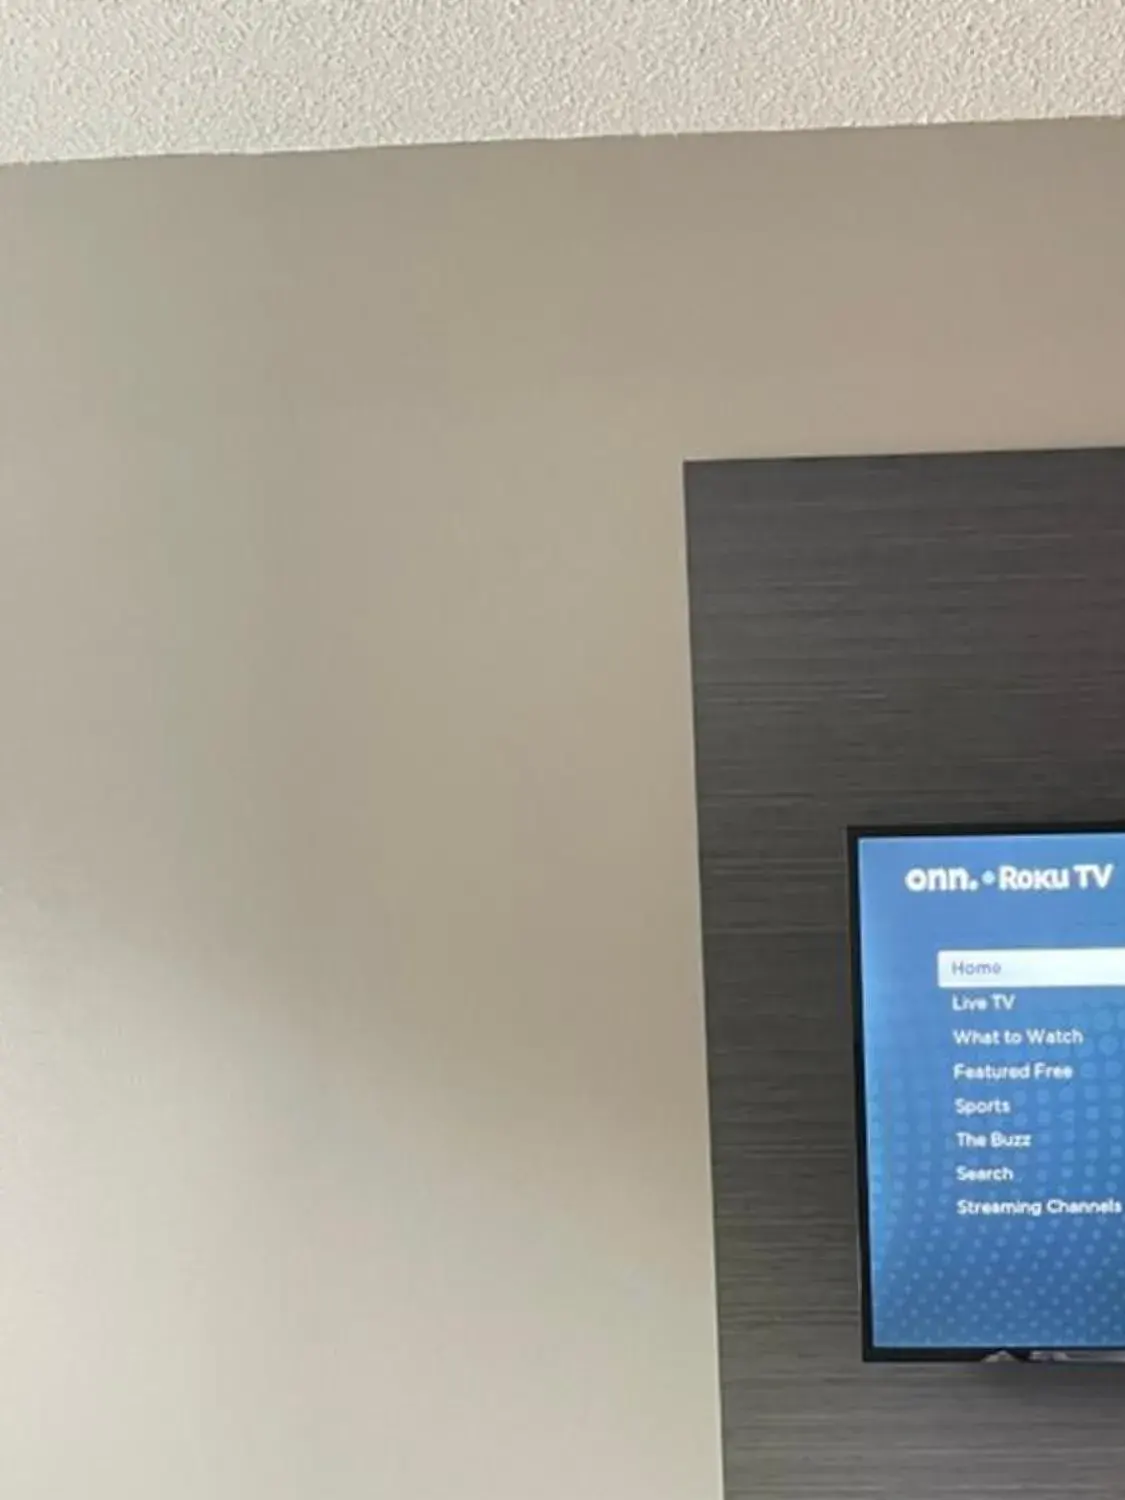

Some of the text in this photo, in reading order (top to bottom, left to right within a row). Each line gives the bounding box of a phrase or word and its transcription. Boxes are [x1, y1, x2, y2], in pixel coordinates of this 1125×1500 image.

[905, 864, 1114, 891] onn. Roku TV
[952, 961, 1001, 975] Home
[952, 994, 1015, 1010] Live TV
[953, 1028, 1084, 1045] What to Watch
[954, 1063, 1073, 1080] Featured Free
[955, 1098, 1011, 1116] Sports
[957, 1132, 1031, 1148] The Buzz
[956, 1166, 1014, 1181] Search
[956, 1198, 1123, 1217] Streaming Channels
